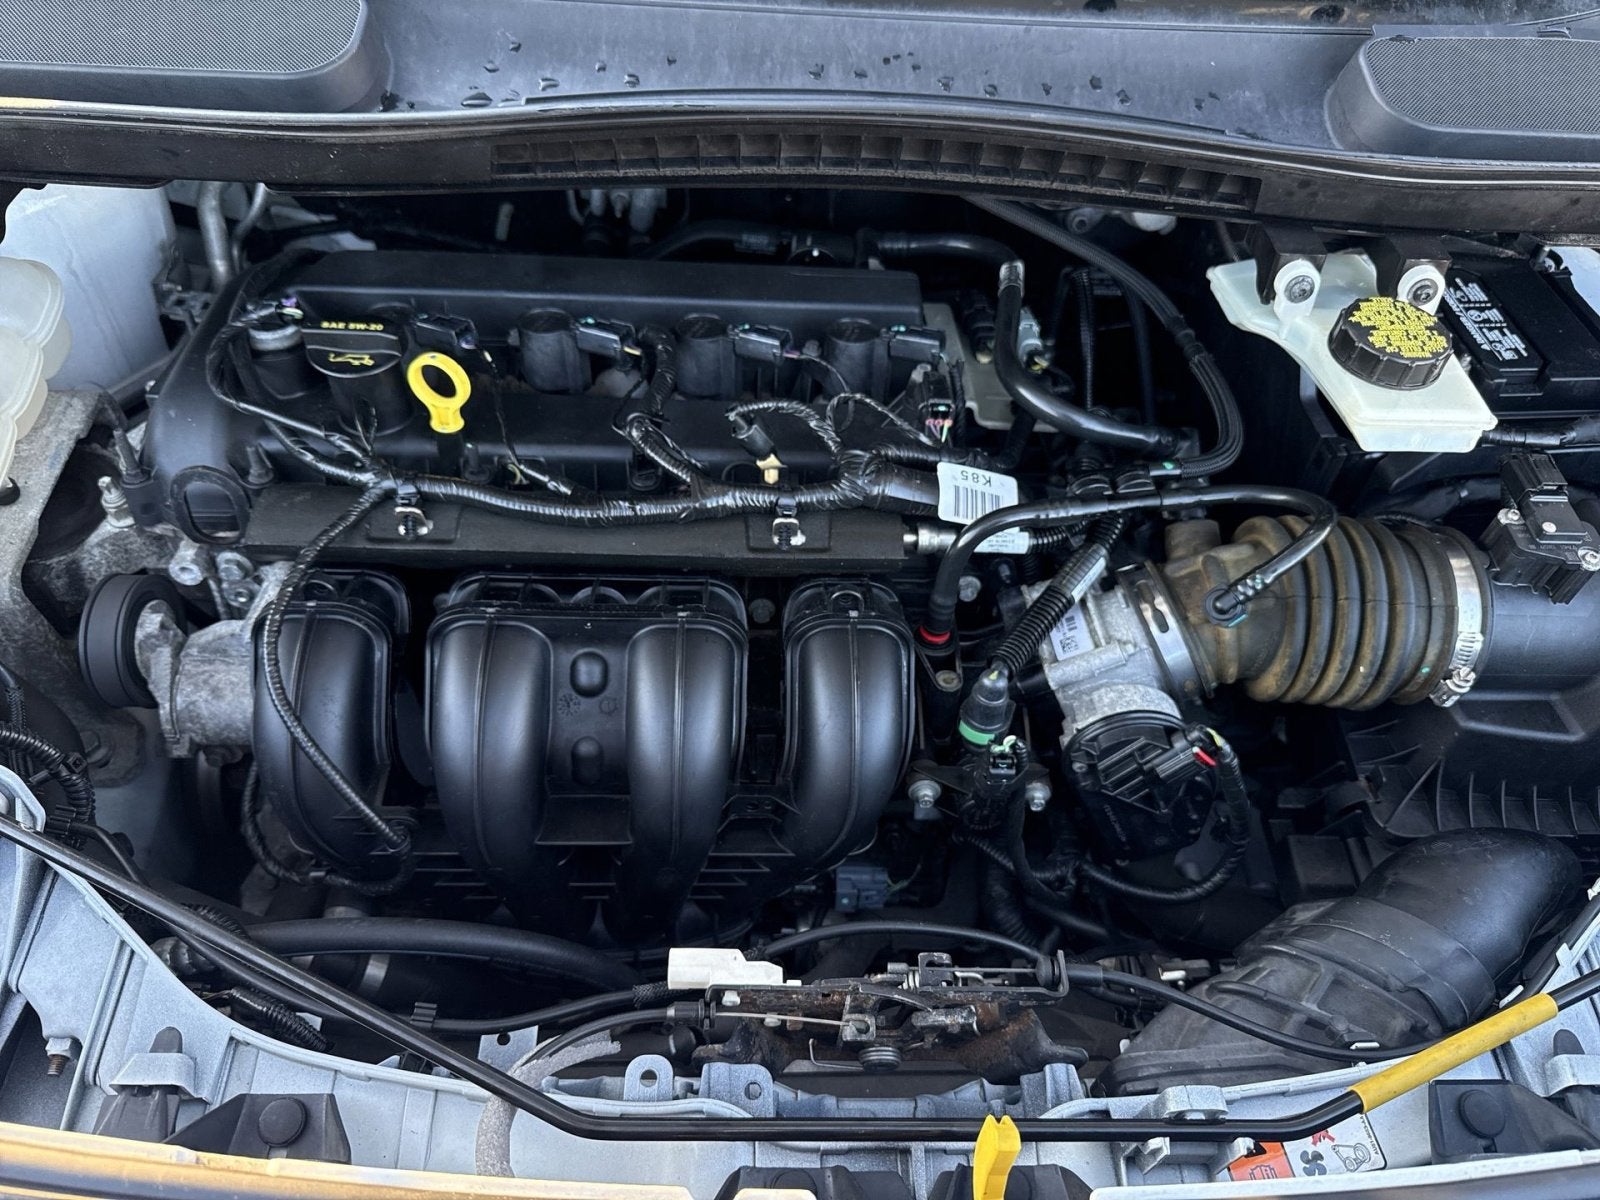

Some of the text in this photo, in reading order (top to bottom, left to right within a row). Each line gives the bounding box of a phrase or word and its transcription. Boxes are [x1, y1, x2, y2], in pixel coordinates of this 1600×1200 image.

[320, 321, 384, 331] SAE 5W-20
[960, 470, 992, 487] K85
